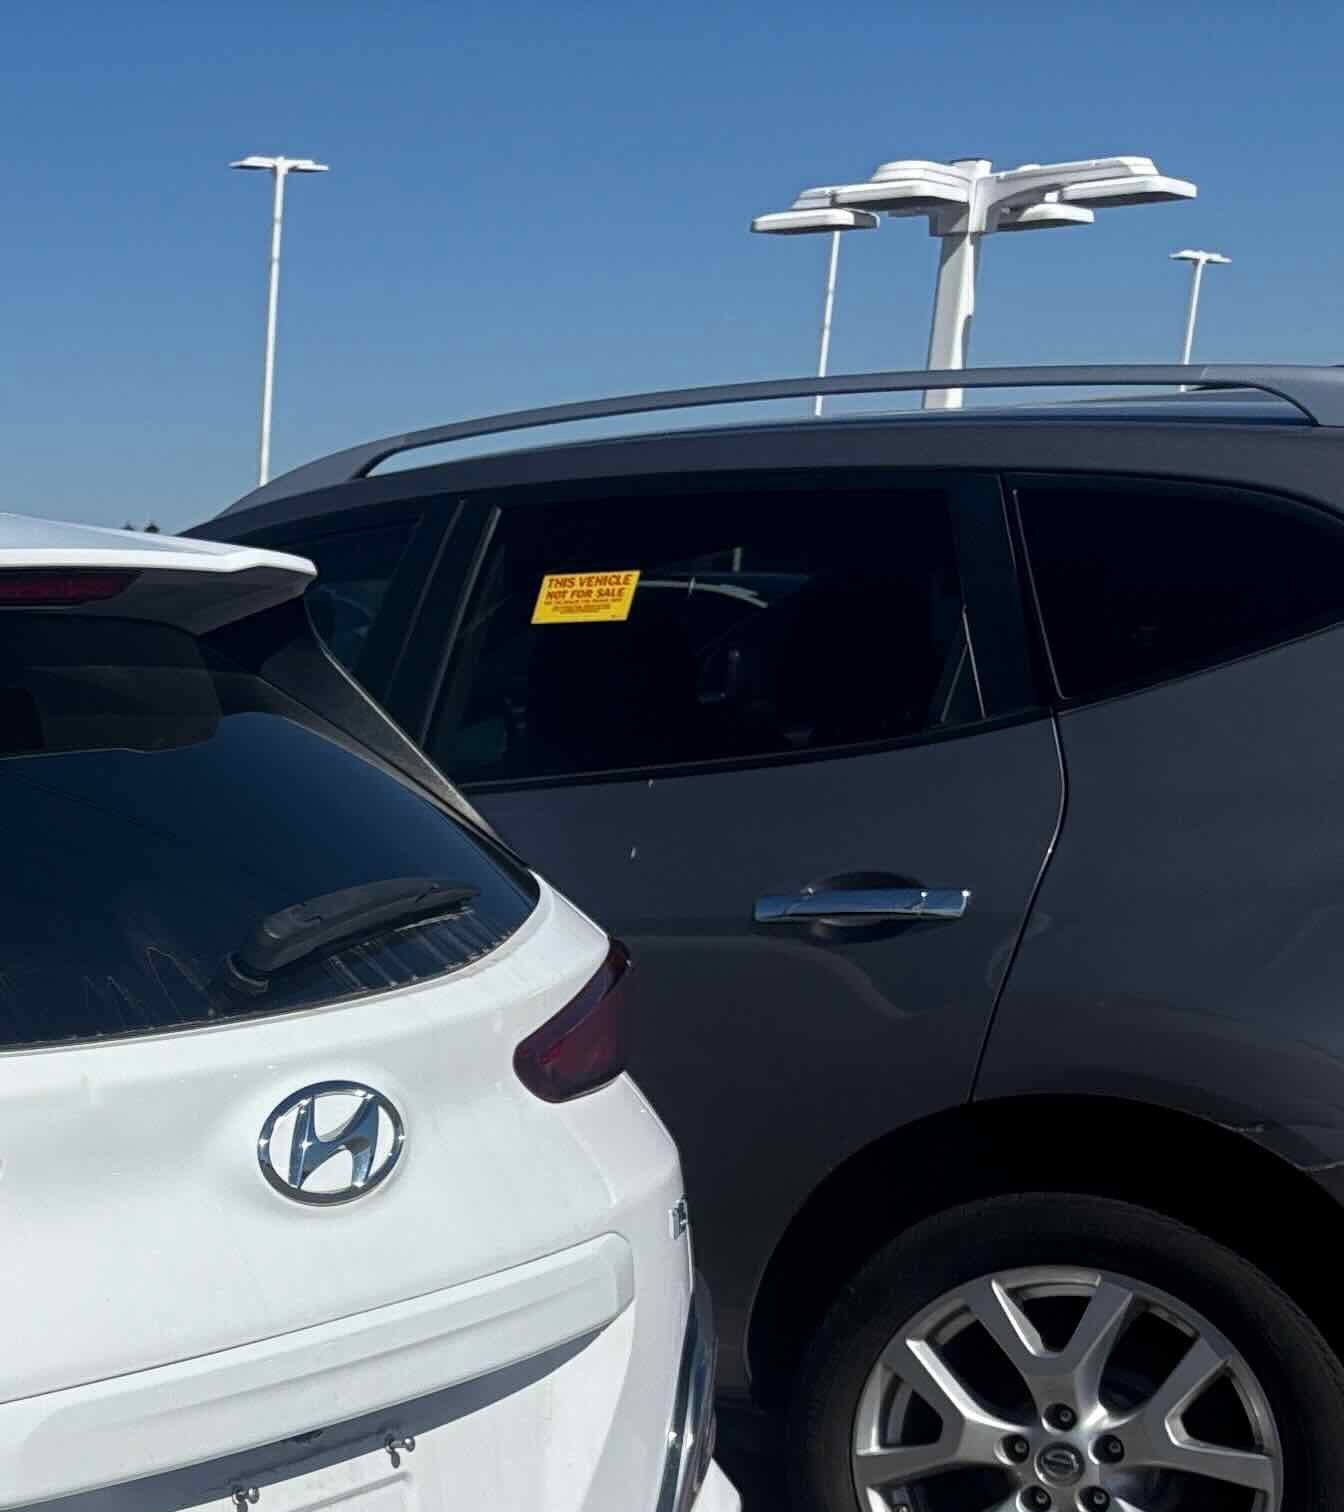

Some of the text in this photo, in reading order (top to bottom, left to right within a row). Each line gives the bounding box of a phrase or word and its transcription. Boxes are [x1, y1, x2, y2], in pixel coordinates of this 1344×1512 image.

[549, 574, 632, 588] THIS VEHICLE
[546, 587, 625, 600] NOT FOR SALE
